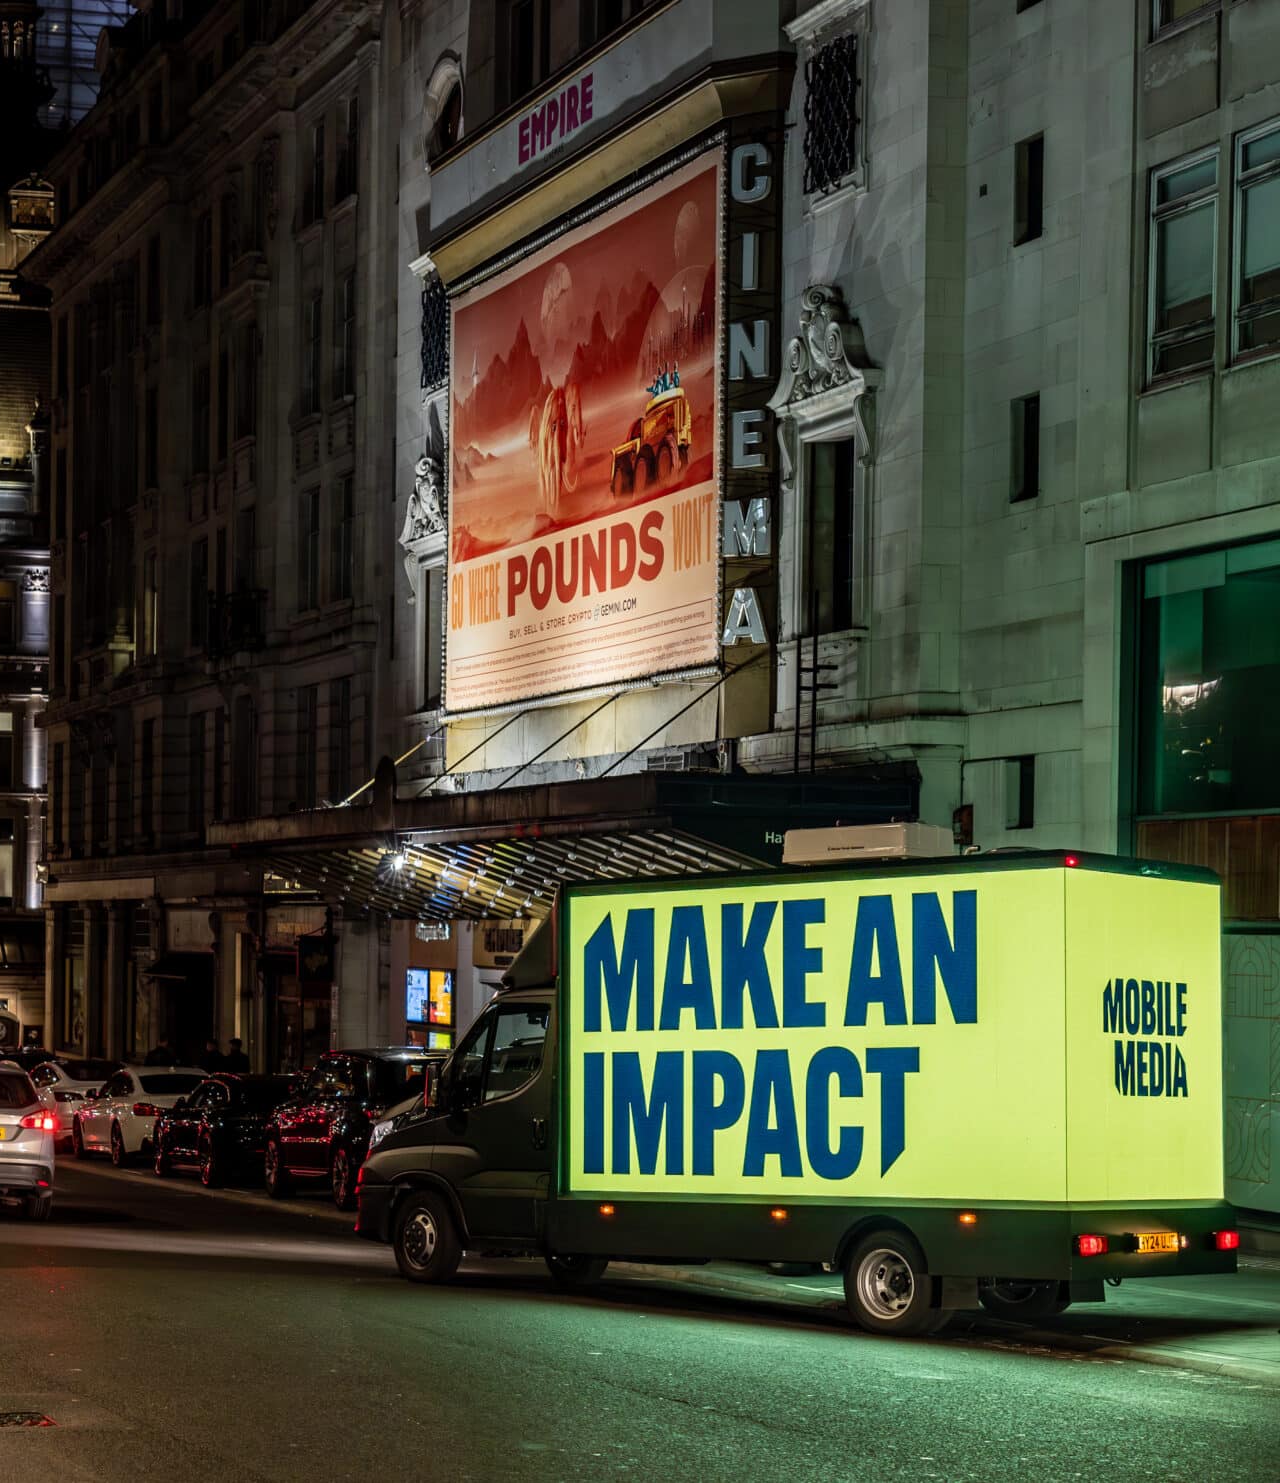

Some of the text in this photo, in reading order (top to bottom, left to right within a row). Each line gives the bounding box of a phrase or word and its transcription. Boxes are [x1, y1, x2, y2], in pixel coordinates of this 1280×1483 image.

[518, 72, 593, 166] EMPIRE
[721, 143, 771, 646] CINEMA
[451, 492, 714, 631] GO WHERE POUNDS WON'T
[524, 626, 538, 635] SELL
[546, 616, 566, 629] STORE
[568, 610, 592, 624] CRYPTO
[584, 890, 978, 1032] MAKE AN
[1103, 978, 1187, 1036] MOBILE
[584, 1046, 920, 1180] IMPACT
[1114, 1040, 1188, 1097] MEDIA
